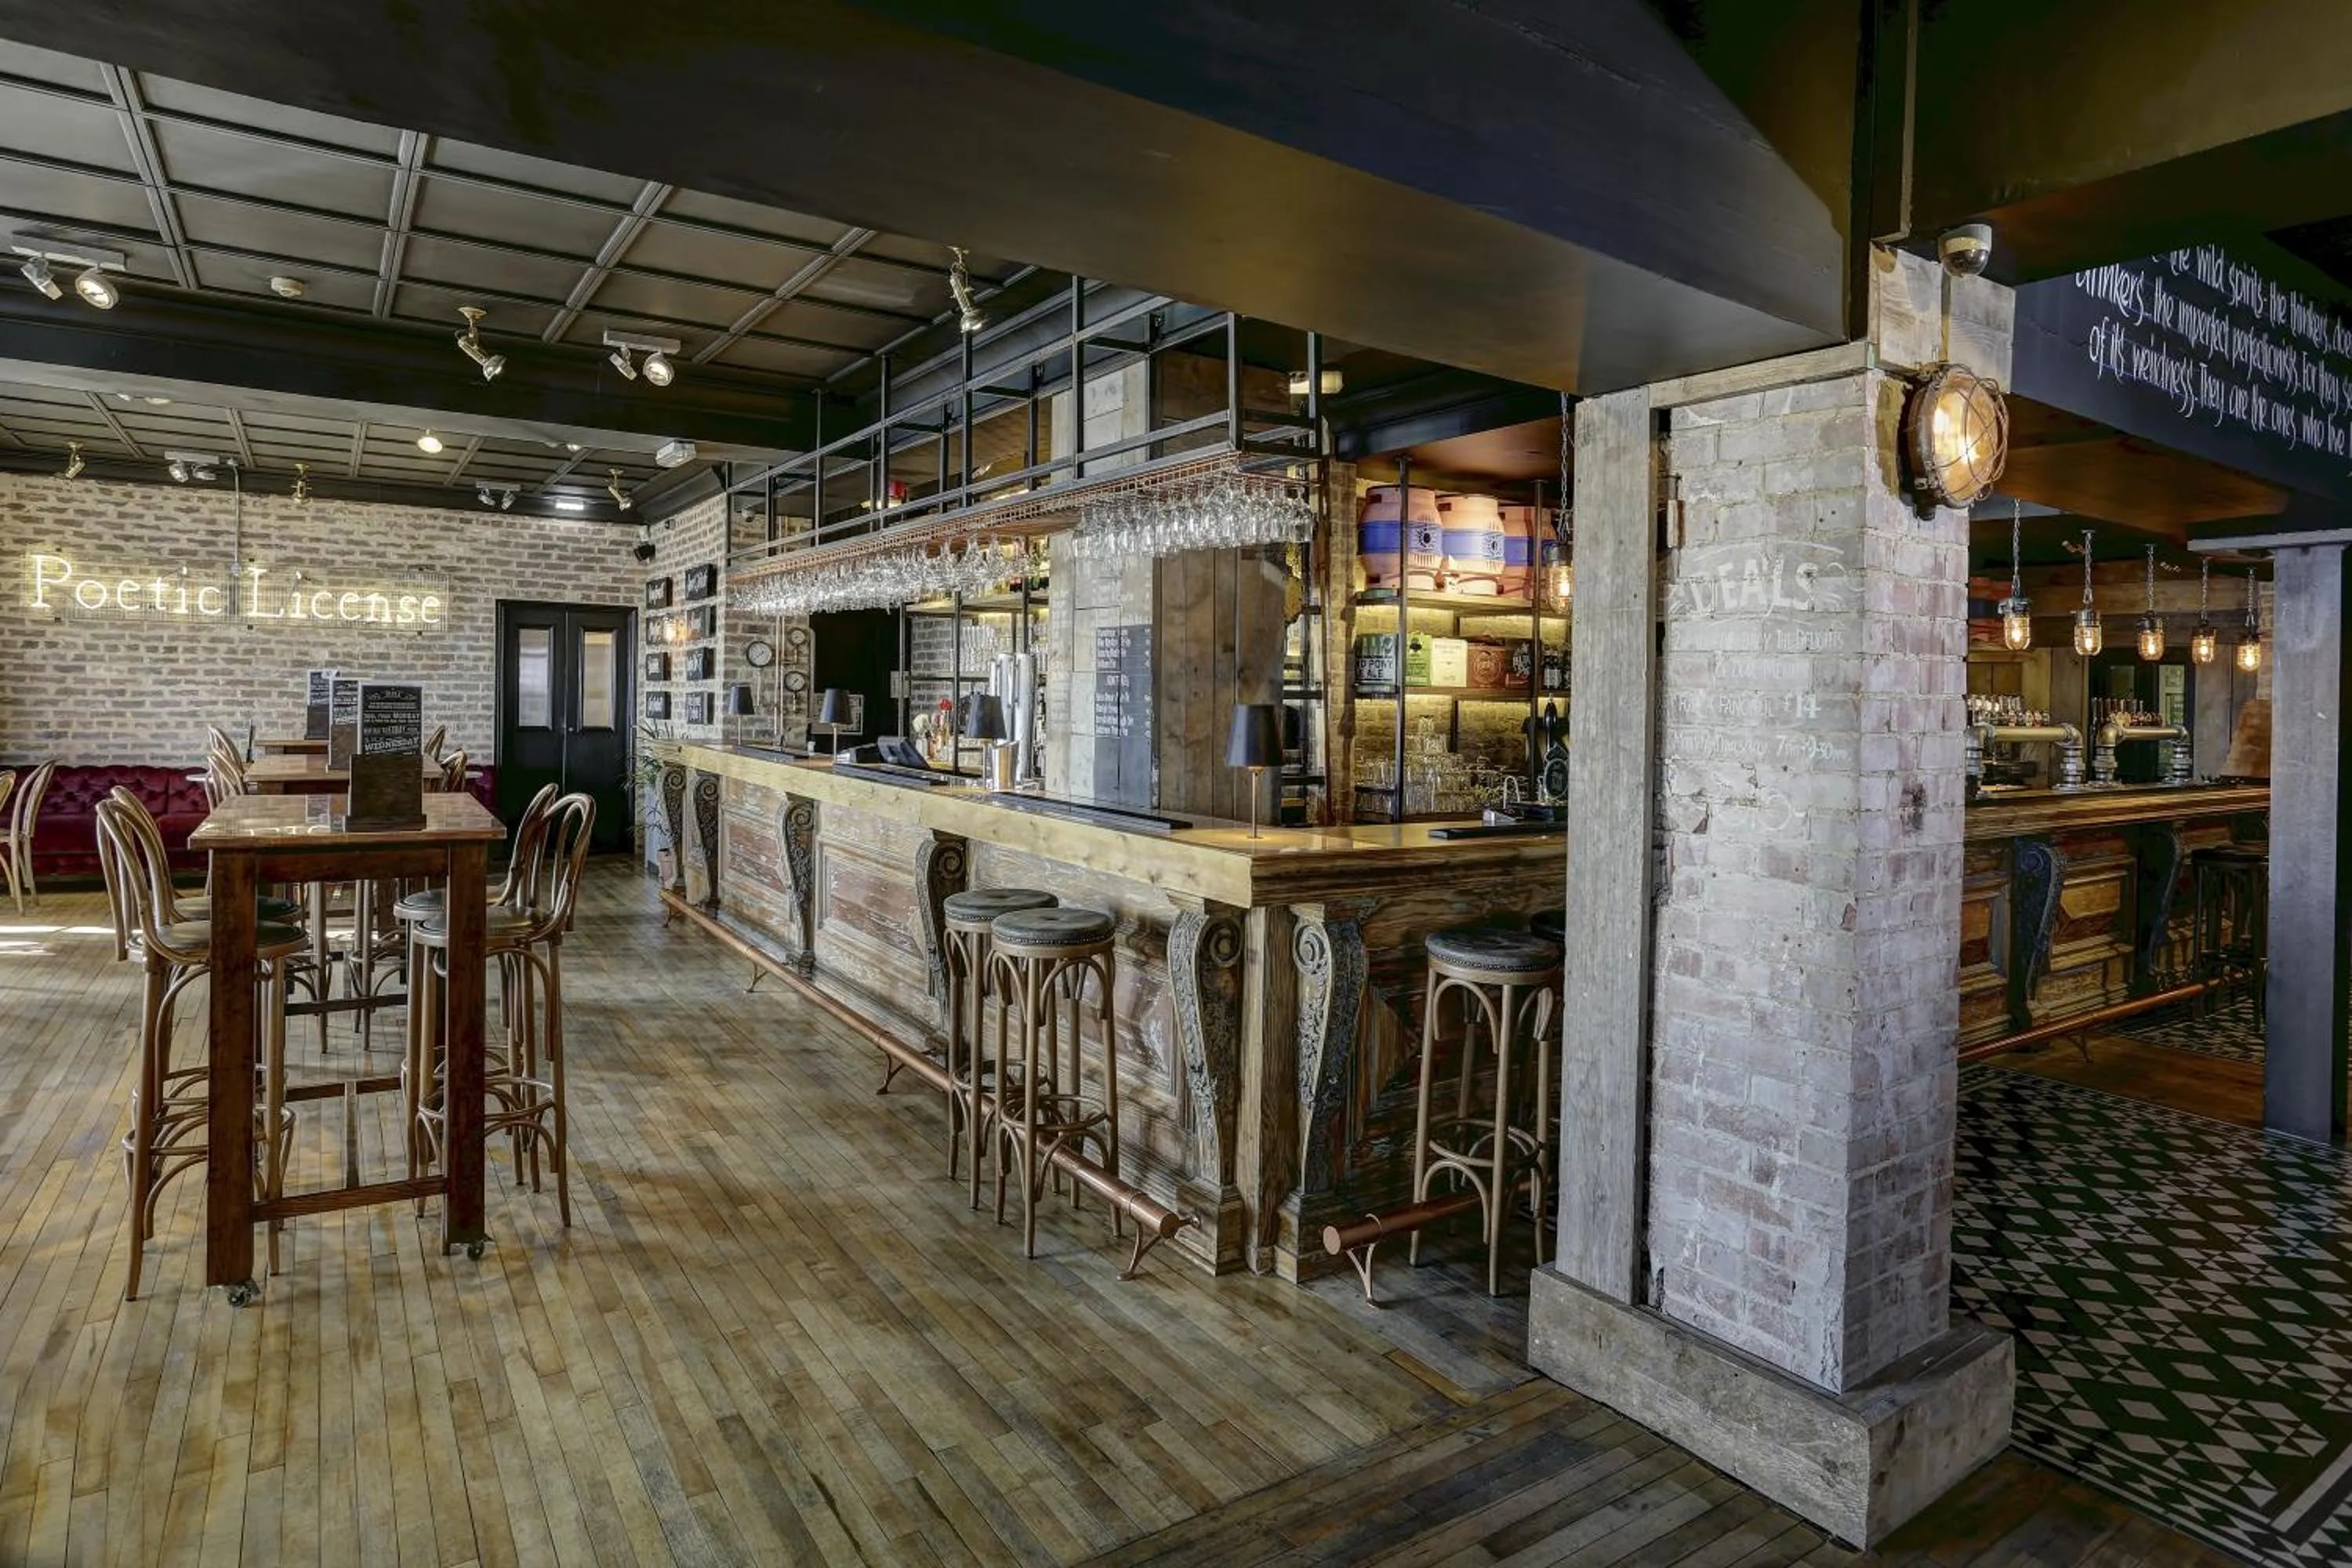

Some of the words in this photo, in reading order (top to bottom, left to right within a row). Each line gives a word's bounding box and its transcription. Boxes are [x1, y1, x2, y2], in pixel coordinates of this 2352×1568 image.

[2197, 243, 2224, 292] wild
[2270, 281, 2287, 328] the
[2199, 362, 2224, 427] They
[2229, 384, 2249, 420] are
[2251, 383, 2267, 431] the
[2271, 401, 2297, 451] ones
[31, 554, 222, 615] Poetic
[247, 567, 441, 623] License
